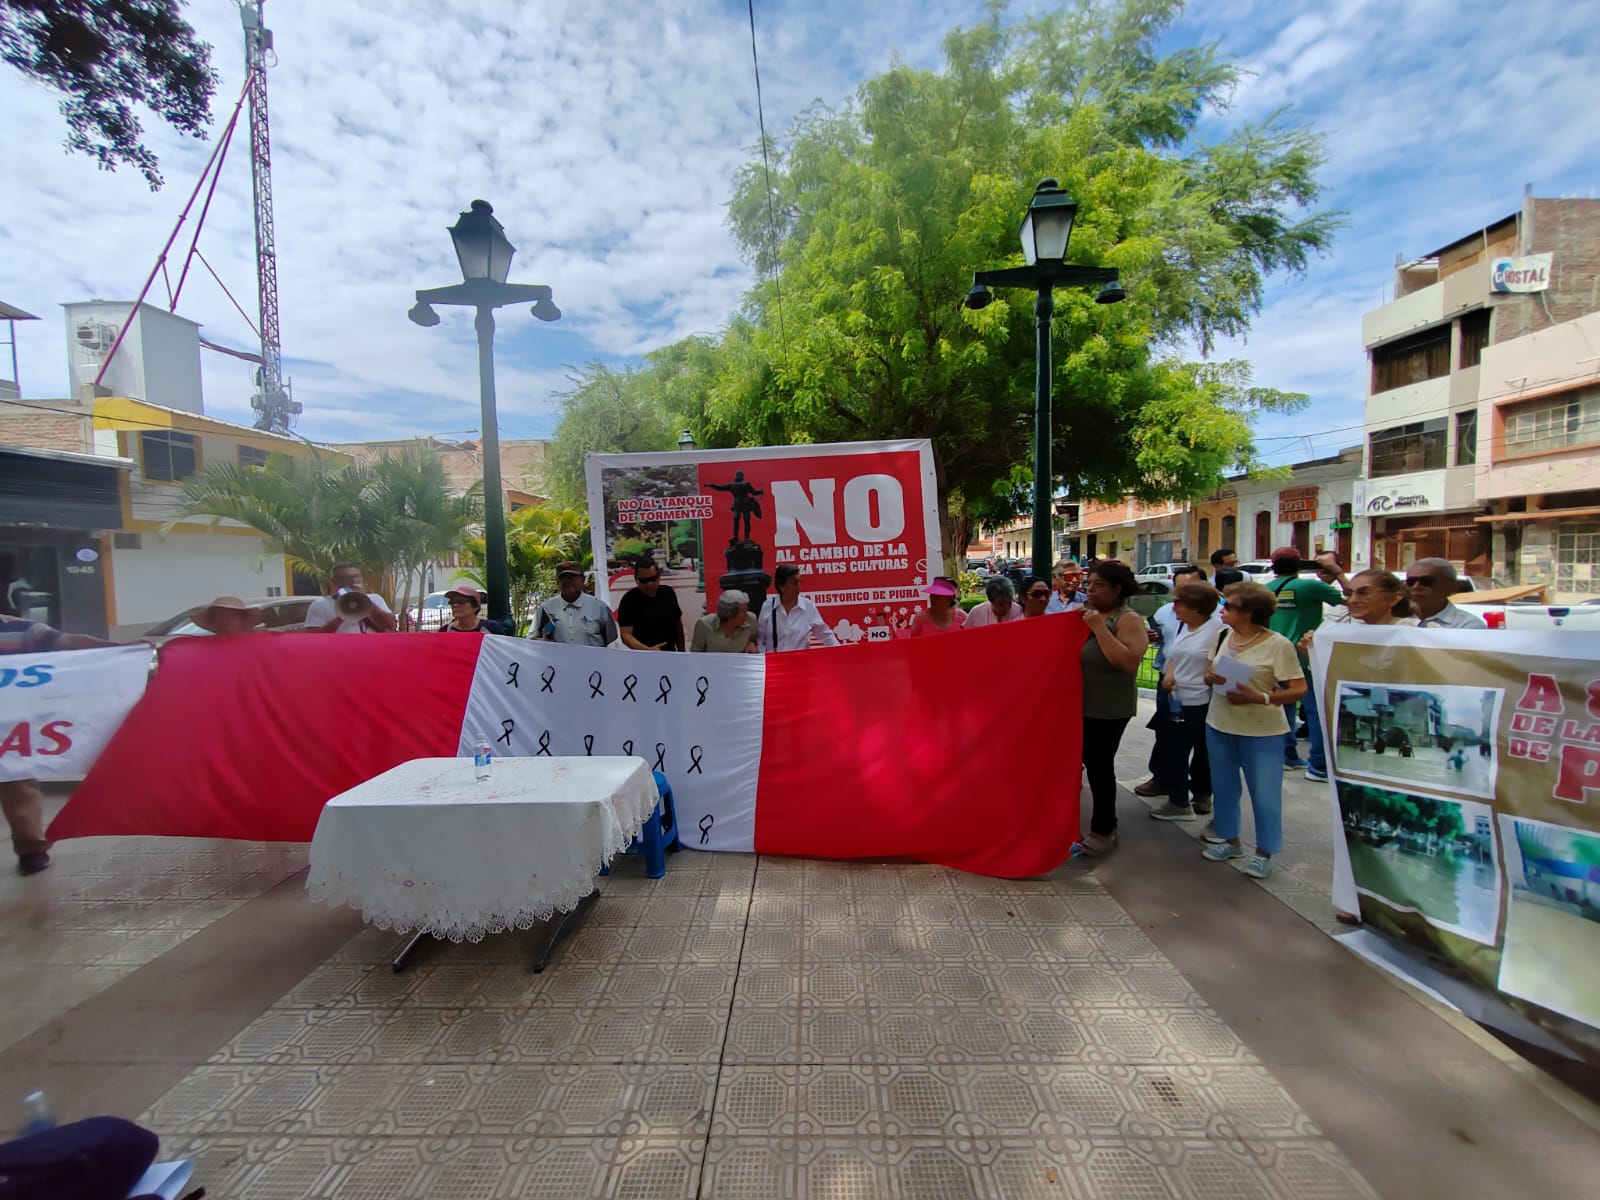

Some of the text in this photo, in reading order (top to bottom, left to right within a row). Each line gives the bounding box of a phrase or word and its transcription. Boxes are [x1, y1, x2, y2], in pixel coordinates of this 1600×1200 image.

[1504, 267, 1546, 284] HOSTAL
[619, 496, 712, 511] NO AL TANQUE
[771, 473, 905, 547] NO
[619, 508, 713, 523] DE TORMENTAS
[775, 543, 909, 563] AL CAMBIO DE LA
[816, 562, 847, 575] TRES
[850, 558, 909, 572] CULTURAS
[814, 591, 871, 604] HISTORICO
[872, 591, 886, 600] DE
[889, 588, 920, 599] PIURA
[1516, 673, 1564, 714] A
[1510, 713, 1557, 736] DE
[1508, 737, 1551, 762] DE
